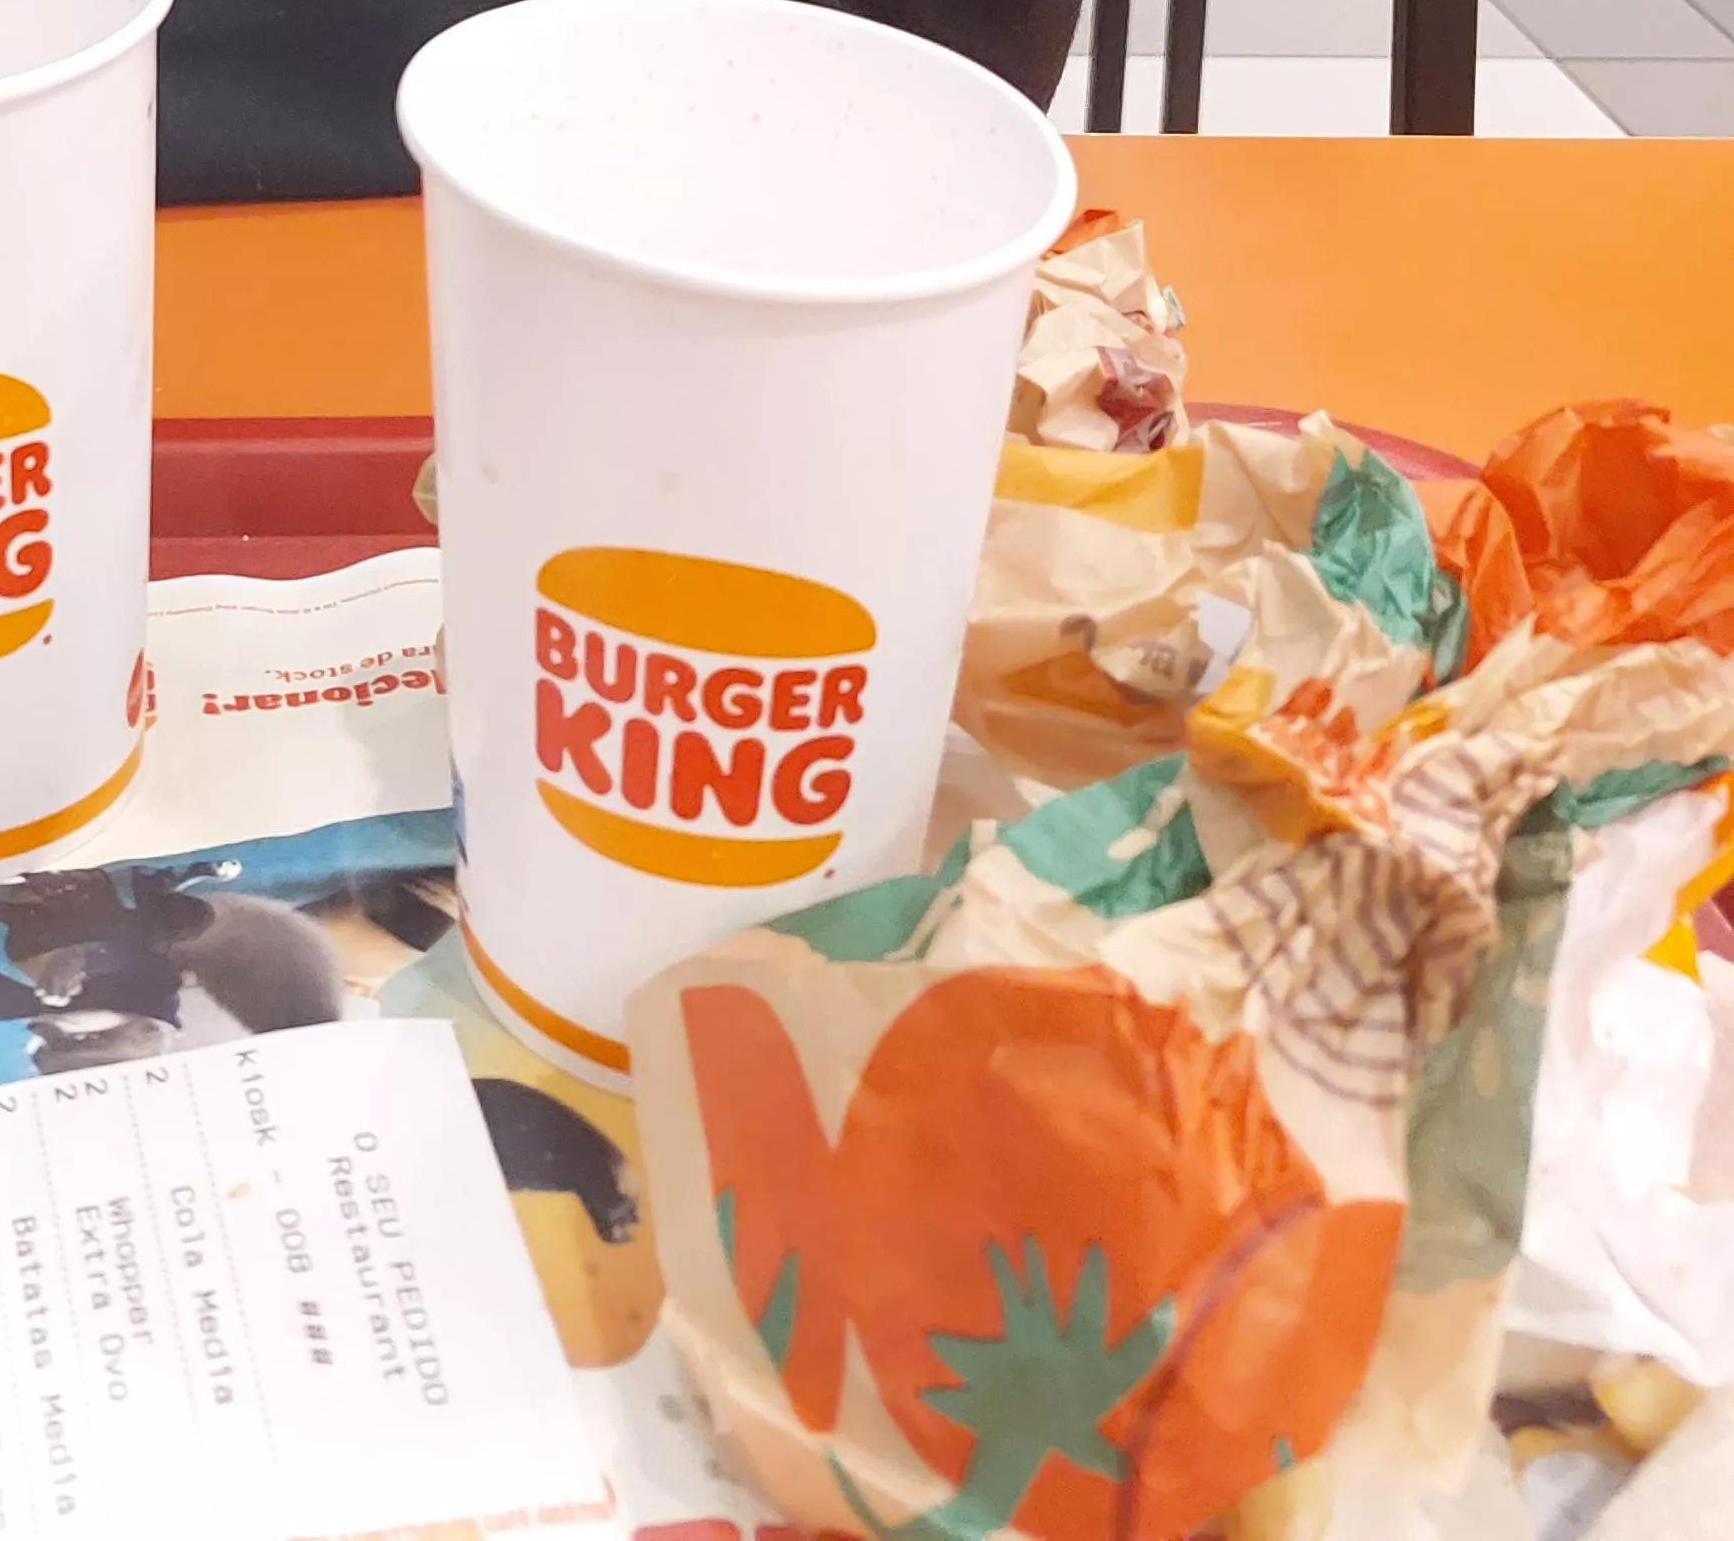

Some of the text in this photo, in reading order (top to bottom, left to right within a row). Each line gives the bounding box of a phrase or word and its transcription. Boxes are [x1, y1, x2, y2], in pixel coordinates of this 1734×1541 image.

[265, 663, 352, 683] stock.
[360, 651, 393, 670] de
[535, 607, 868, 731] BURGER
[535, 678, 856, 827] KING
[54, 1085, 127, 1402] 2 Extra Ovo
[84, 1078, 155, 1346] 2 Whopper
[145, 1067, 233, 1405] 2 Cola Media
[328, 1155, 405, 1382] Restaurant
[366, 1173, 405, 1239] SEU
[392, 1261, 448, 1408] PEDIDO
[12, 1216, 53, 1370] Batatas
[40, 1394, 78, 1517] Media
